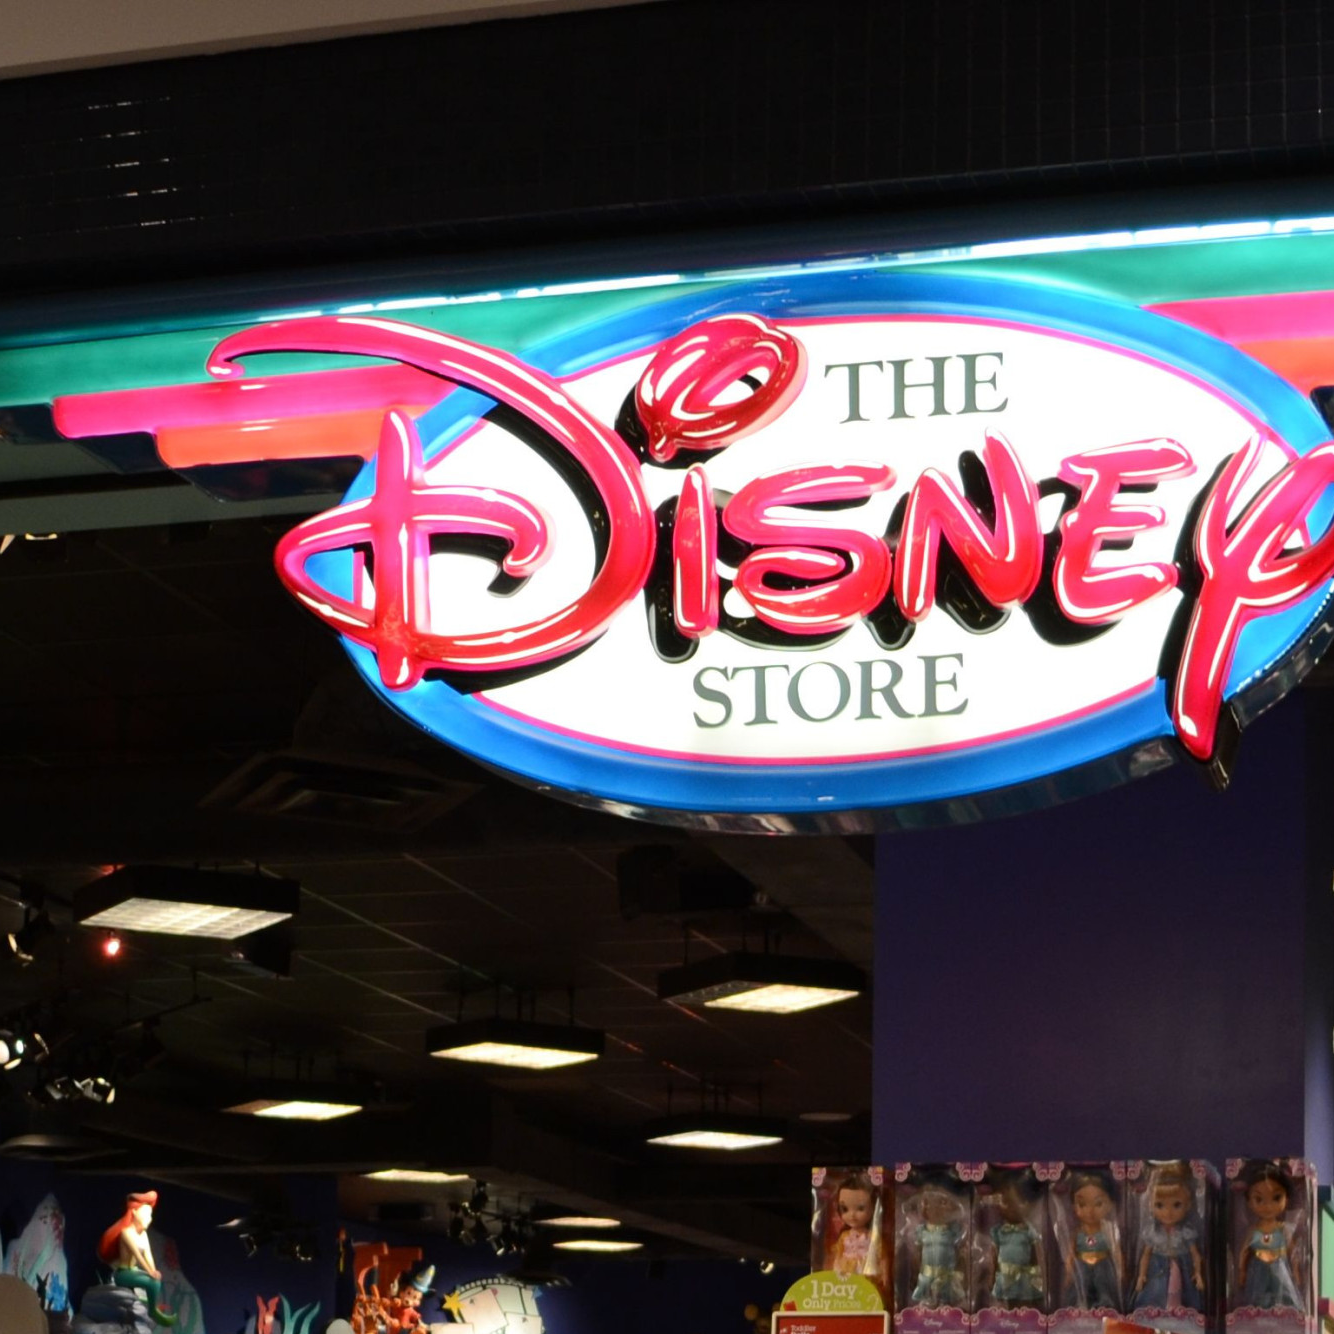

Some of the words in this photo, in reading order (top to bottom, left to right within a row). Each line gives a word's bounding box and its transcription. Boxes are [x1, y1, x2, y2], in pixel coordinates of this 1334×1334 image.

[824, 351, 1009, 424] THE
[692, 652, 969, 729] STORE
[802, 1298, 831, 1310] Only
[811, 1279, 819, 1299] 1
[822, 1281, 857, 1299] Day
